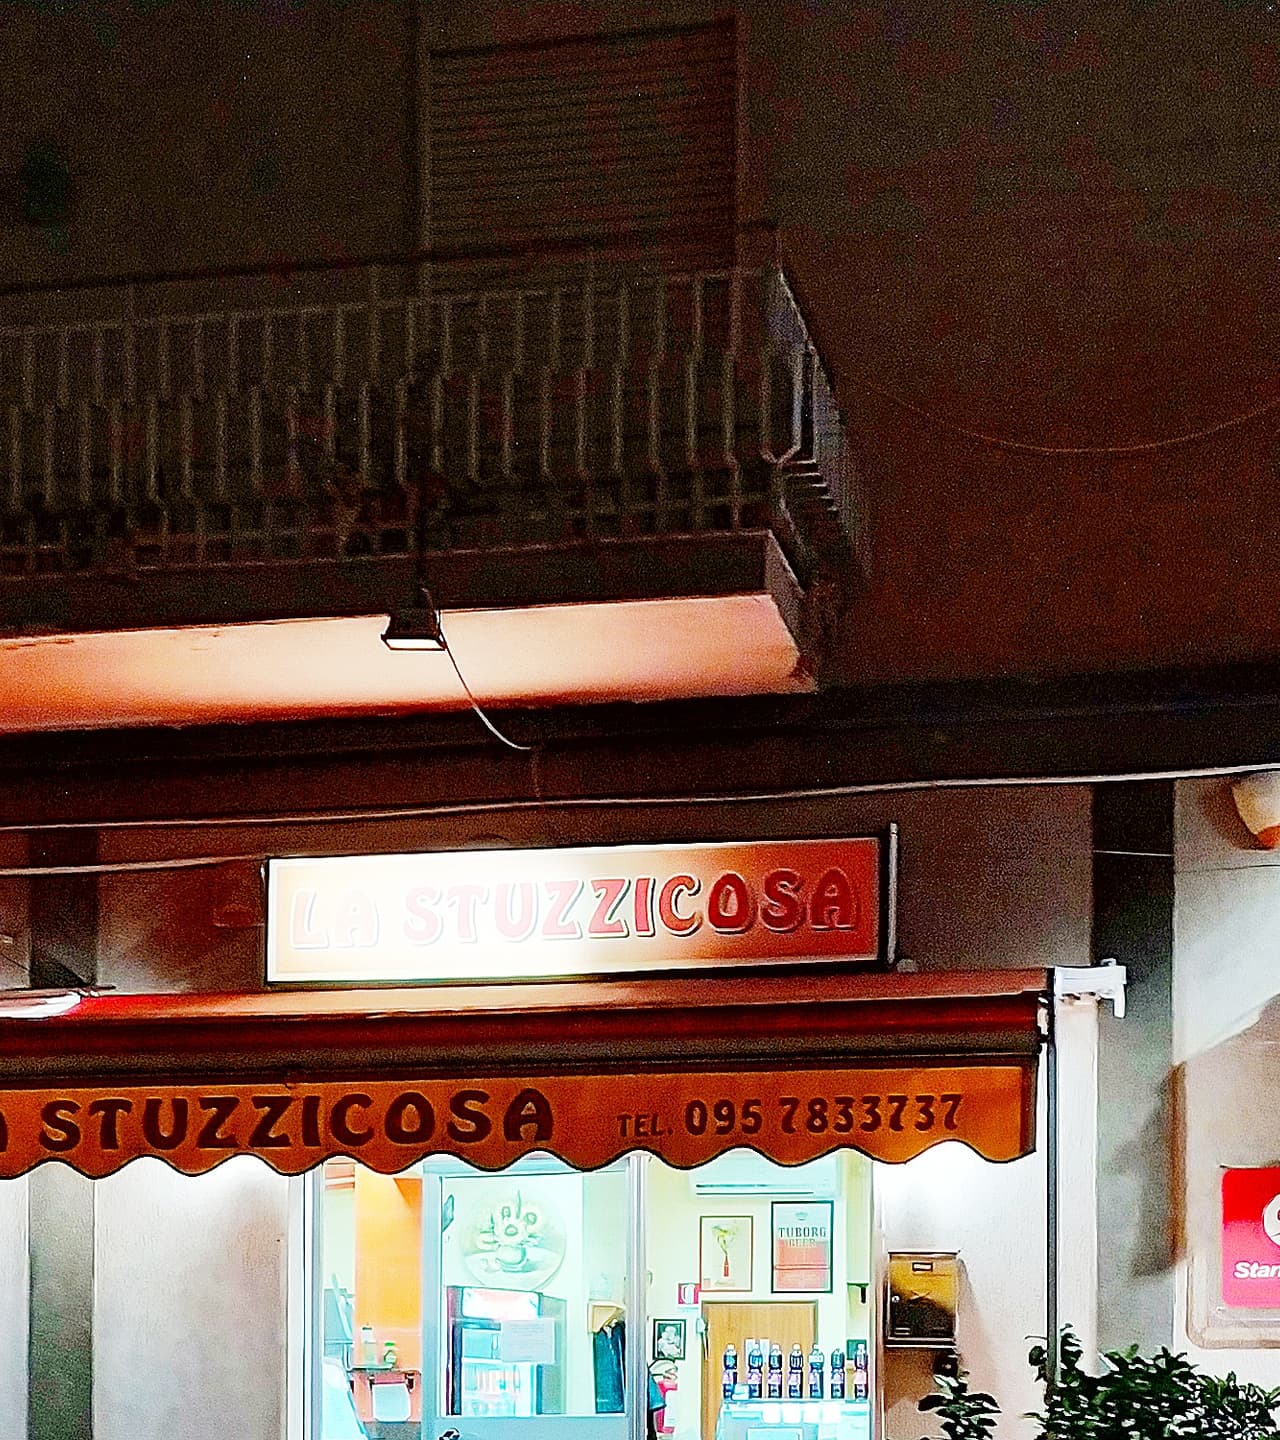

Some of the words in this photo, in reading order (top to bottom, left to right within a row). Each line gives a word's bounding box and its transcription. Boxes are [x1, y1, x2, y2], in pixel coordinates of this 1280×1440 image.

[290, 888, 380, 950] LA
[403, 867, 861, 946] STUZZICOSA
[39, 1087, 555, 1151] STUZZICOSA
[617, 1112, 674, 1138] TEL.
[685, 1099, 764, 1136] 095
[779, 1093, 963, 1134] 7833737
[778, 1226, 826, 1238] TUBORG
